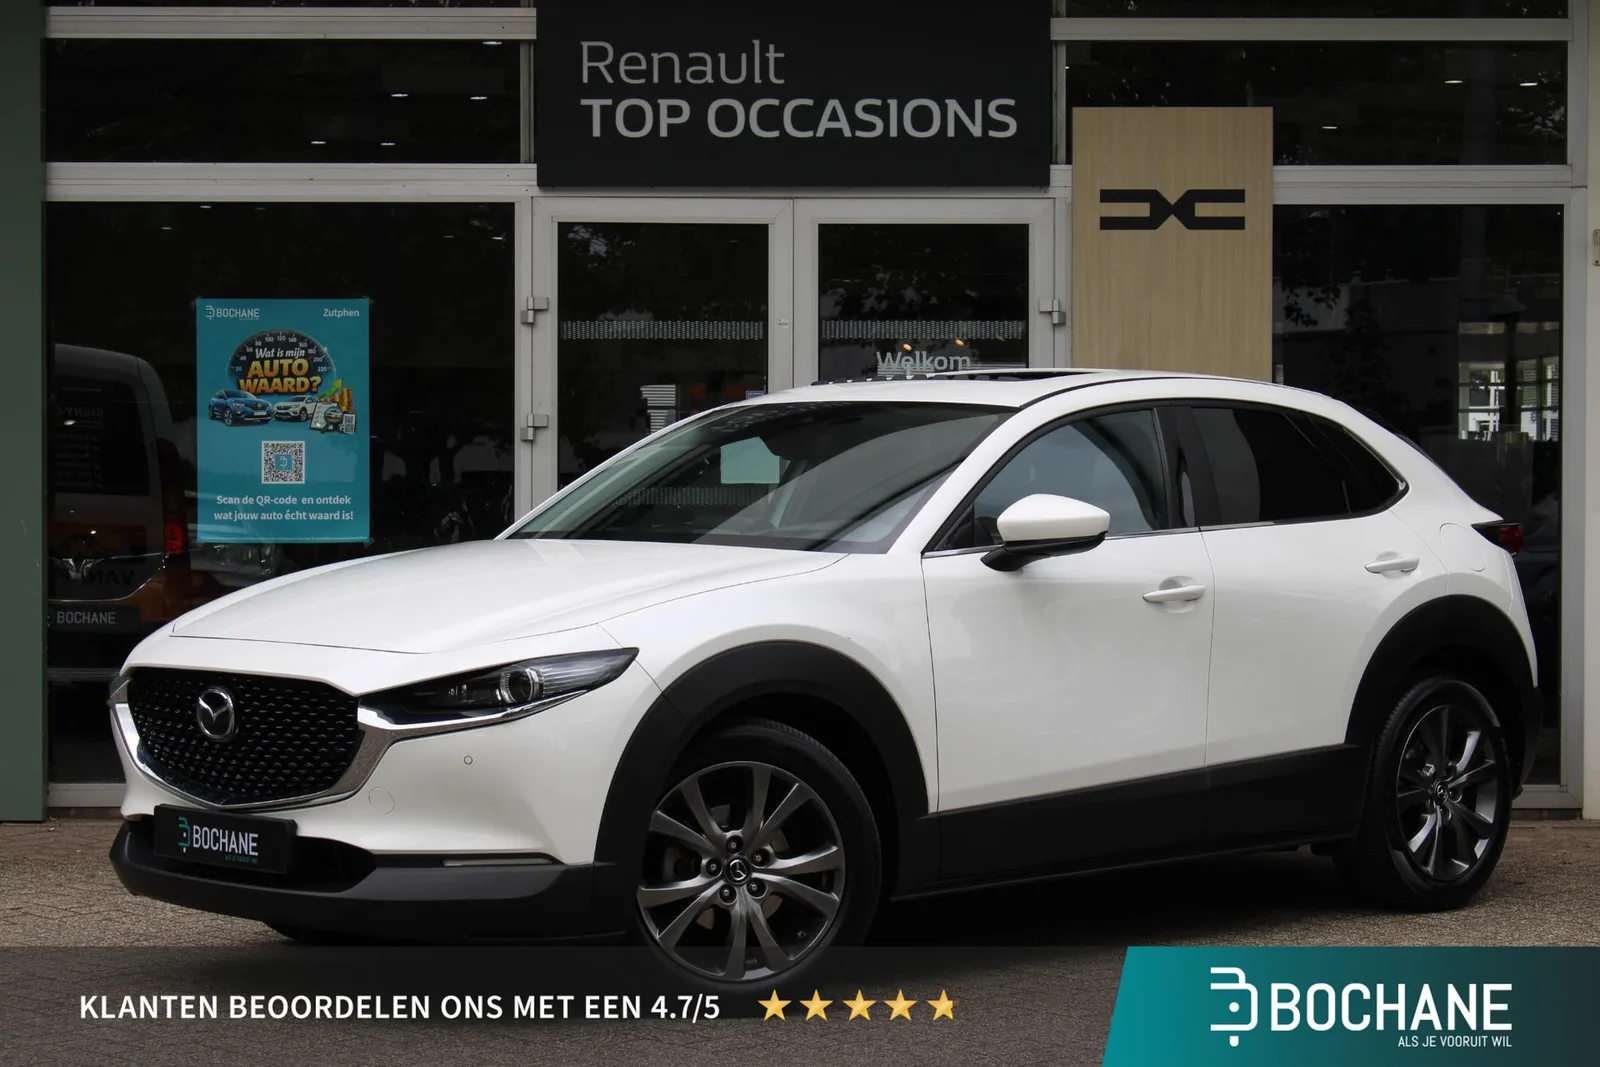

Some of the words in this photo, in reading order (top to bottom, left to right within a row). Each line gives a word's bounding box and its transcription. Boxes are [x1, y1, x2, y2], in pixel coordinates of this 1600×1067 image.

[580, 39, 785, 84] Renault
[580, 98, 691, 138] TOP
[707, 98, 1018, 138] OCCASIONS
[216, 308, 260, 318] BOCHANE
[323, 308, 360, 319] Zutphen
[255, 348, 275, 359] Wat
[276, 348, 284, 358] is
[285, 348, 306, 358] mijn
[876, 351, 971, 370] Welkom
[248, 358, 309, 378] AUTO
[239, 376, 321, 394] WAARD?
[216, 495, 240, 505] Scan
[242, 495, 254, 505] de
[256, 495, 298, 507] QR-code
[301, 497, 314, 505] en
[316, 495, 351, 505] ontdek
[214, 512, 233, 520] wat
[233, 511, 258, 522] jouw
[260, 512, 283, 520] auto
[284, 510, 307, 520] écht
[309, 511, 340, 520] waard
[341, 511, 354, 520] is!
[57, 611, 116, 624] BOCHANE
[193, 825, 259, 856] BOCHANE
